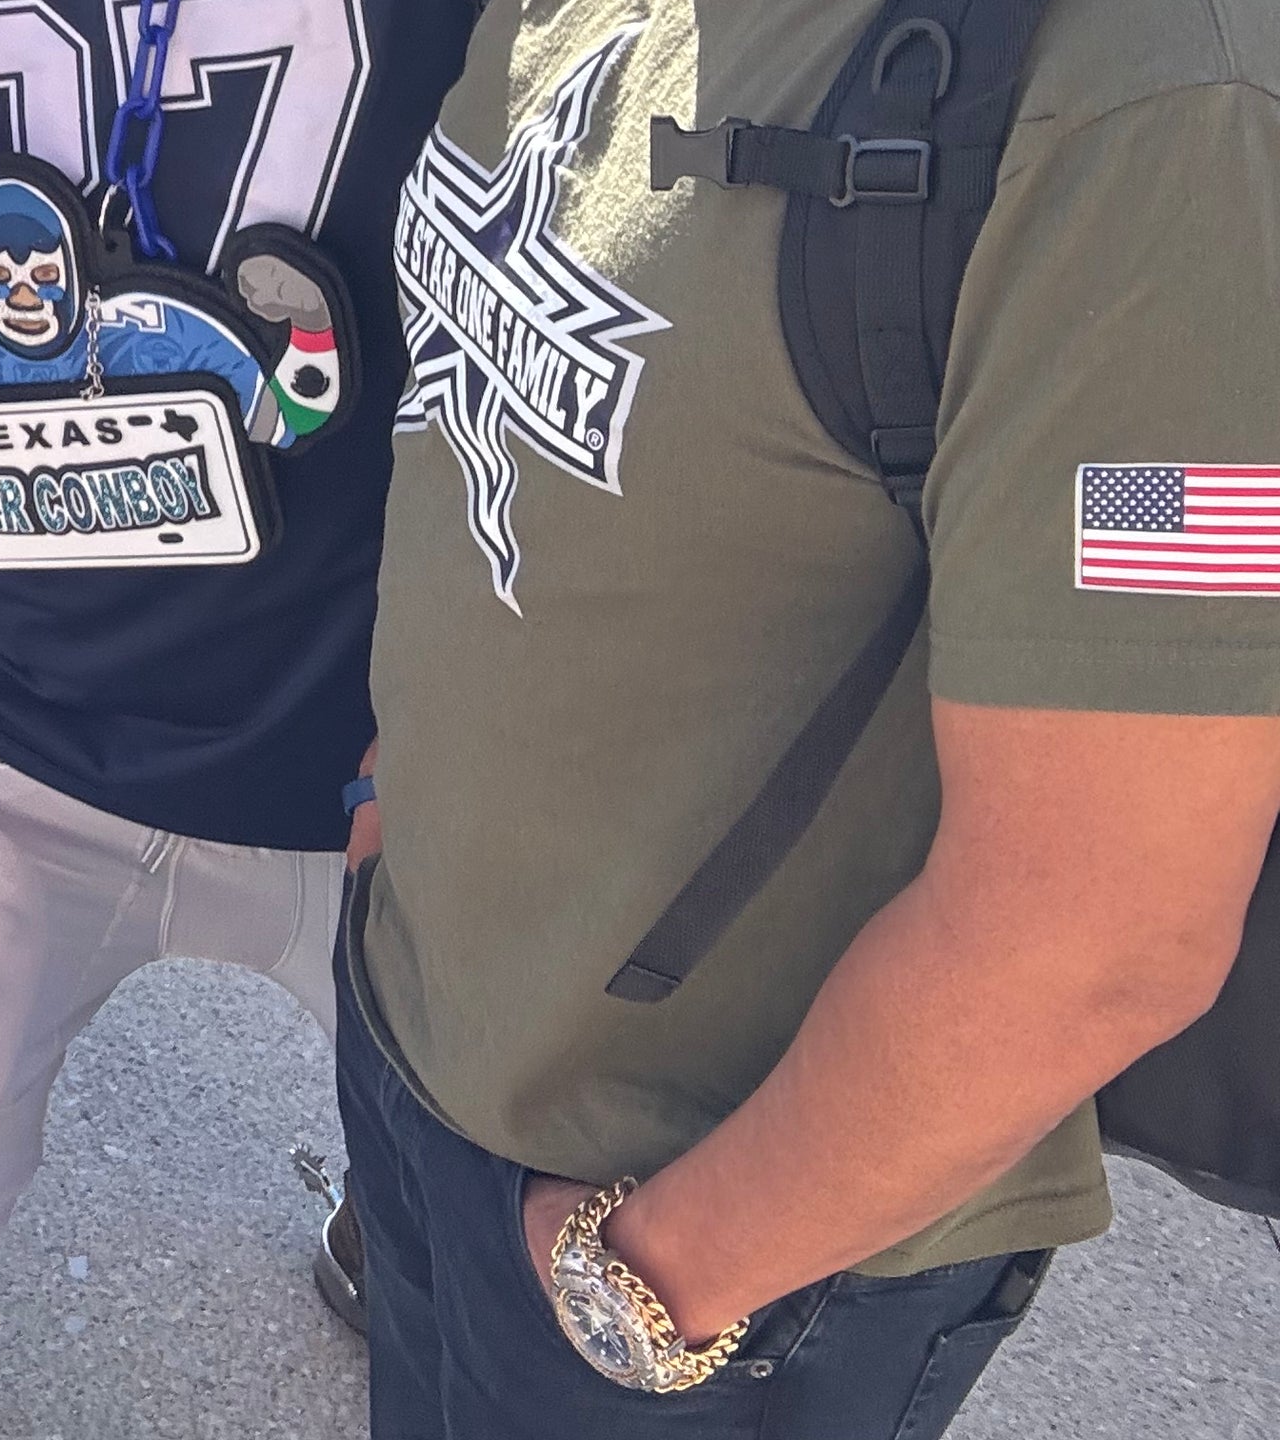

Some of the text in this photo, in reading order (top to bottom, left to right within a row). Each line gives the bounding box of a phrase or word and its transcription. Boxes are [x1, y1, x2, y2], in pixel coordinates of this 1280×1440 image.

[409, 215, 457, 316] STAR
[455, 265, 499, 358] ONE
[497, 302, 609, 444] FAMILY
[34, 452, 211, 534] COWBOY
